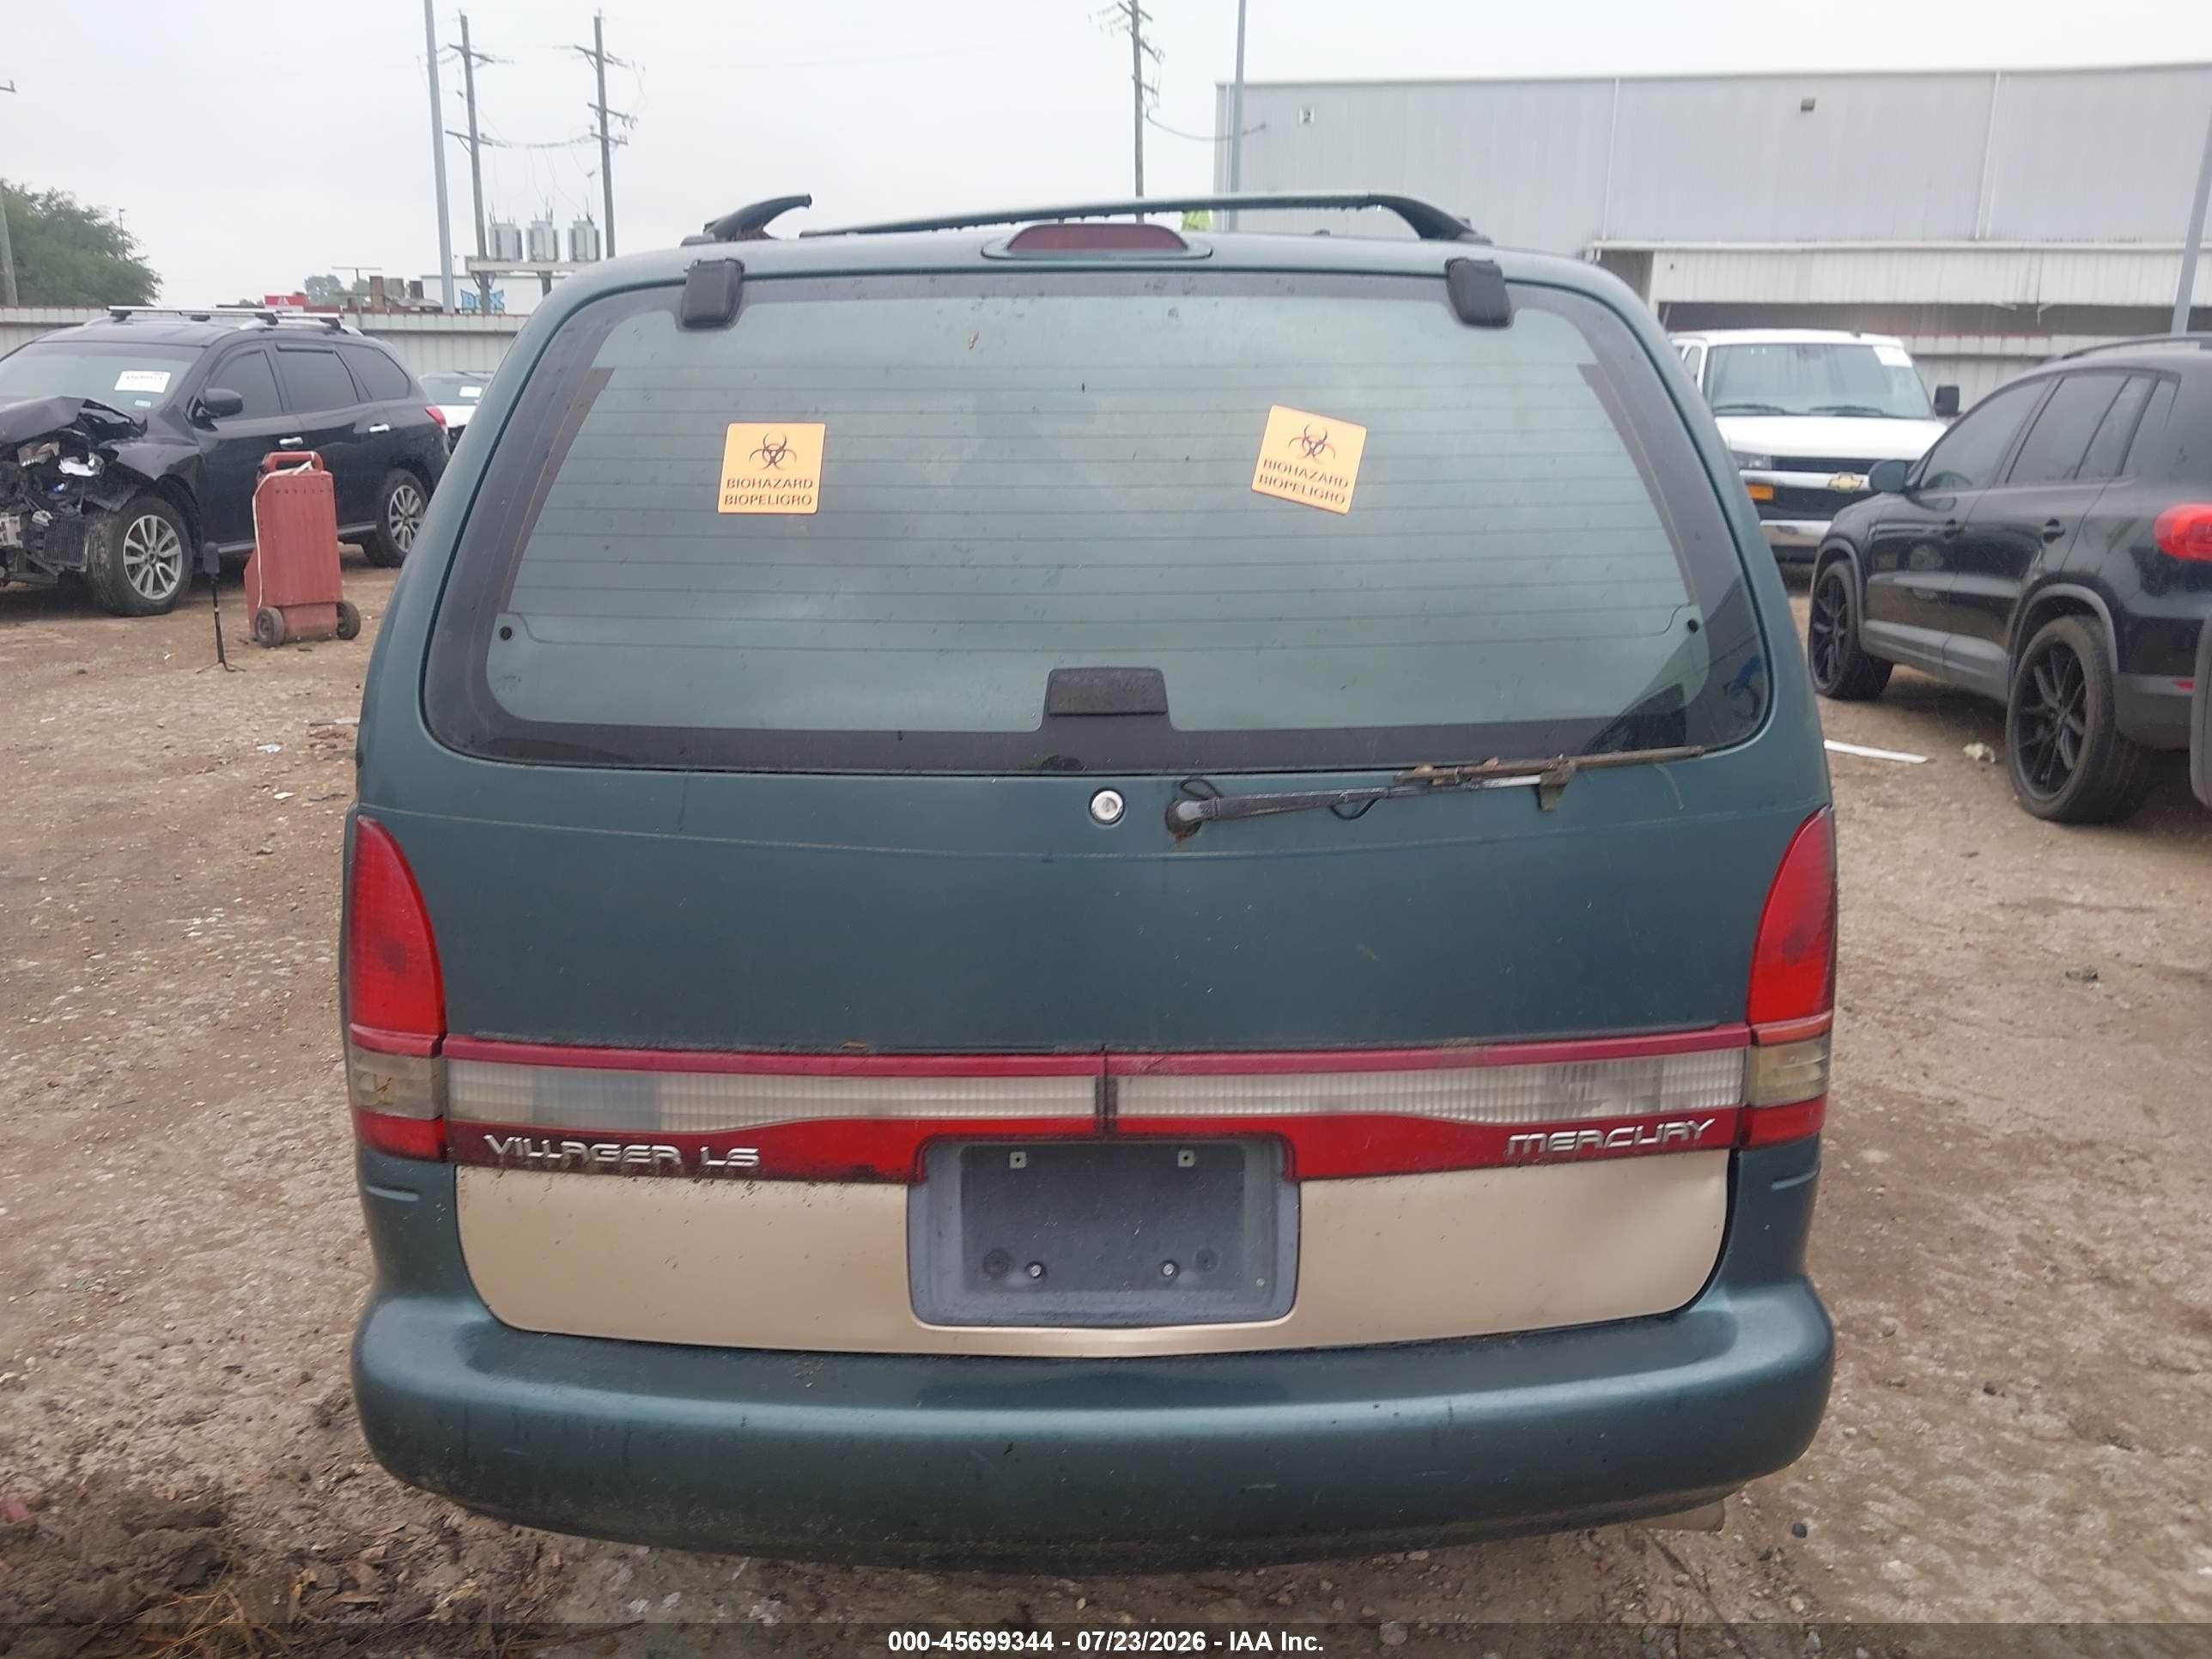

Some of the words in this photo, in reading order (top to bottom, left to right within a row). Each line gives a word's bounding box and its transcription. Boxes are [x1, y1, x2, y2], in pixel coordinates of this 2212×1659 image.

[726, 477, 813, 489] BIOHAZARD
[1259, 473, 1346, 505] BIOPELIGRO
[1262, 458, 1349, 489] BIOHAZARD
[724, 494, 812, 506] BIOPELIGRO
[483, 1134, 682, 1165] VILLAGER
[699, 1146, 760, 1167] LS
[1507, 1118, 1716, 1156] MERCURY
